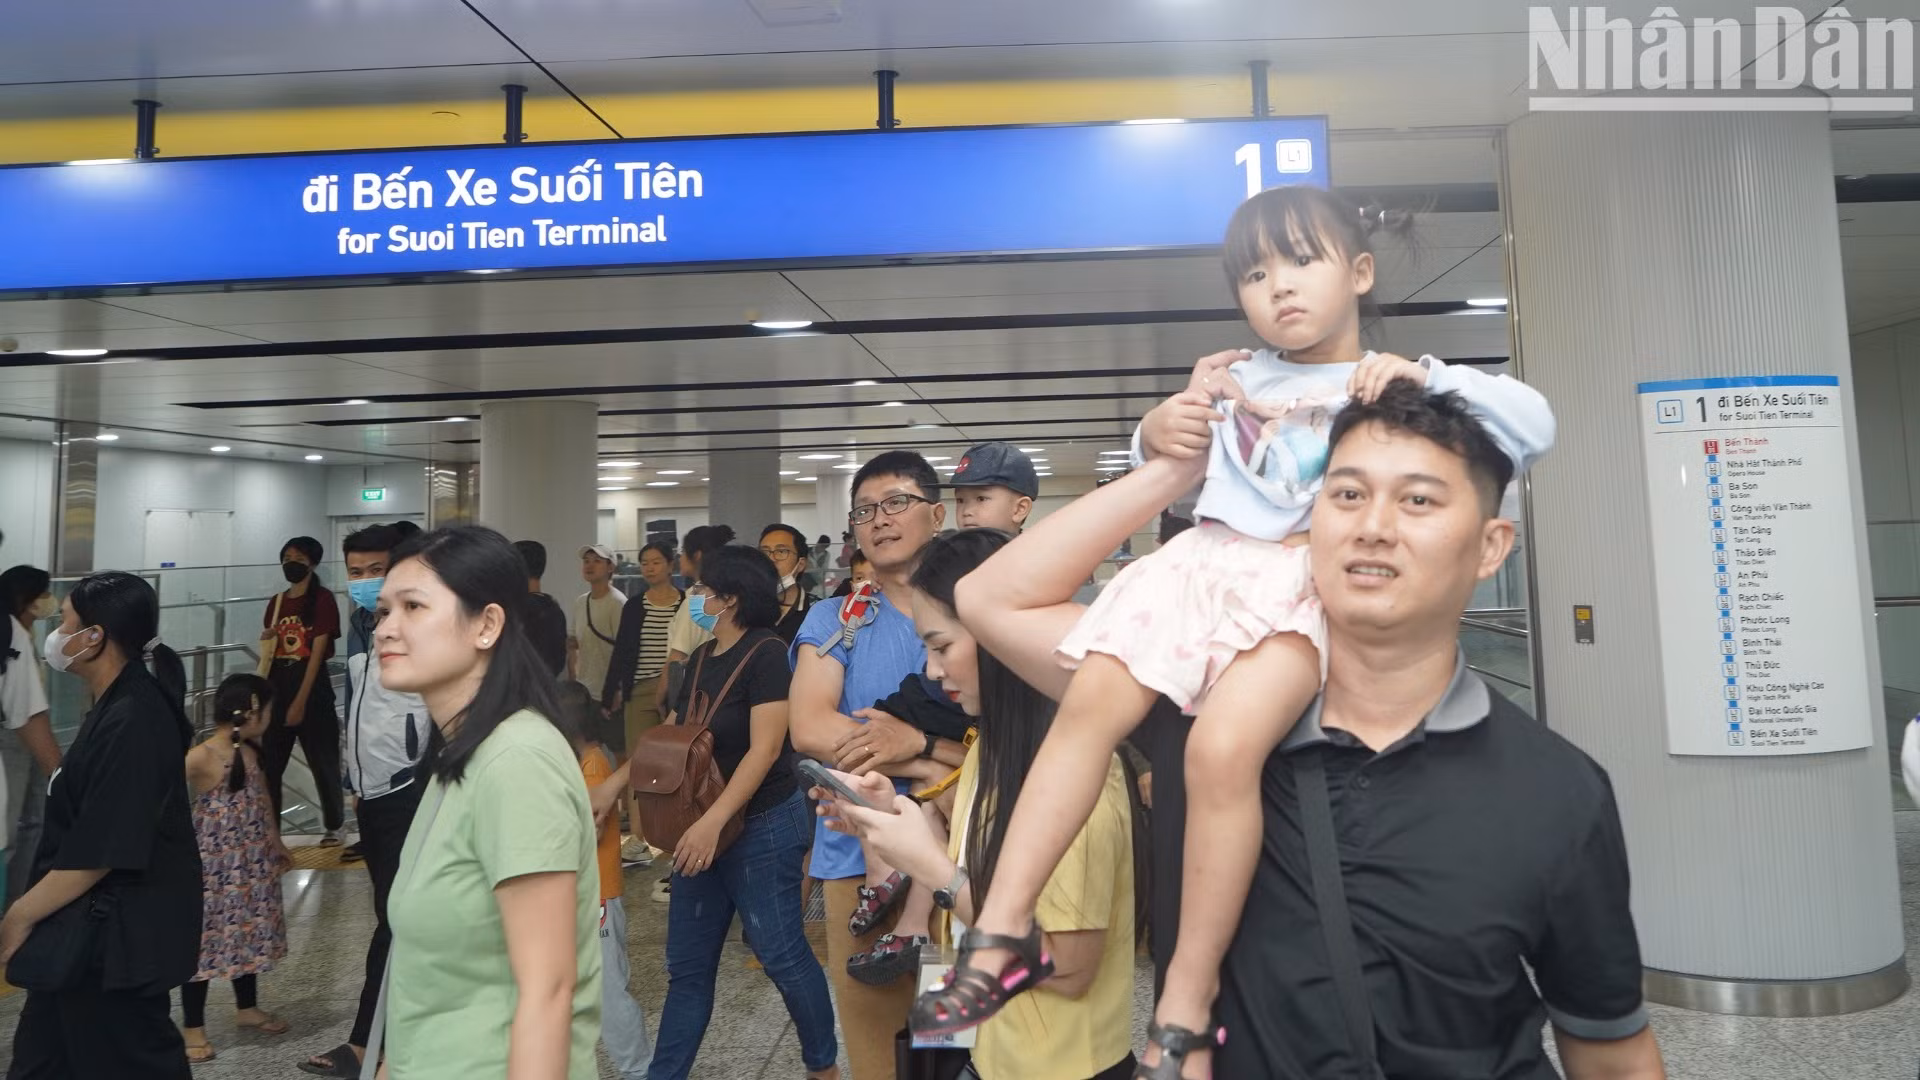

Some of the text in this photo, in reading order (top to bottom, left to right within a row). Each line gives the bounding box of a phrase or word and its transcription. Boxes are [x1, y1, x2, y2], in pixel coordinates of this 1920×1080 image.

[1235, 144, 1262, 200] 1
[303, 159, 703, 213] đi Bến Xe Suối Tiên
[338, 215, 668, 255] for Suoi Tien Terminal
[1718, 393, 1828, 408] đi Bến Xe Suối Tiên
[1665, 407, 1677, 417] L1
[1696, 397, 1707, 423] 1
[1720, 411, 1814, 422] for Suoi Tien Terminal
[1725, 438, 1742, 447] Bến
[1731, 505, 1753, 514] Công
[1770, 616, 1790, 625] Long
[1766, 684, 1787, 693] Công
[1811, 682, 1824, 690] Cao
[1805, 705, 1817, 713] Gia
[1750, 730, 1767, 738] Bến
[1769, 730, 1780, 738] Xe
